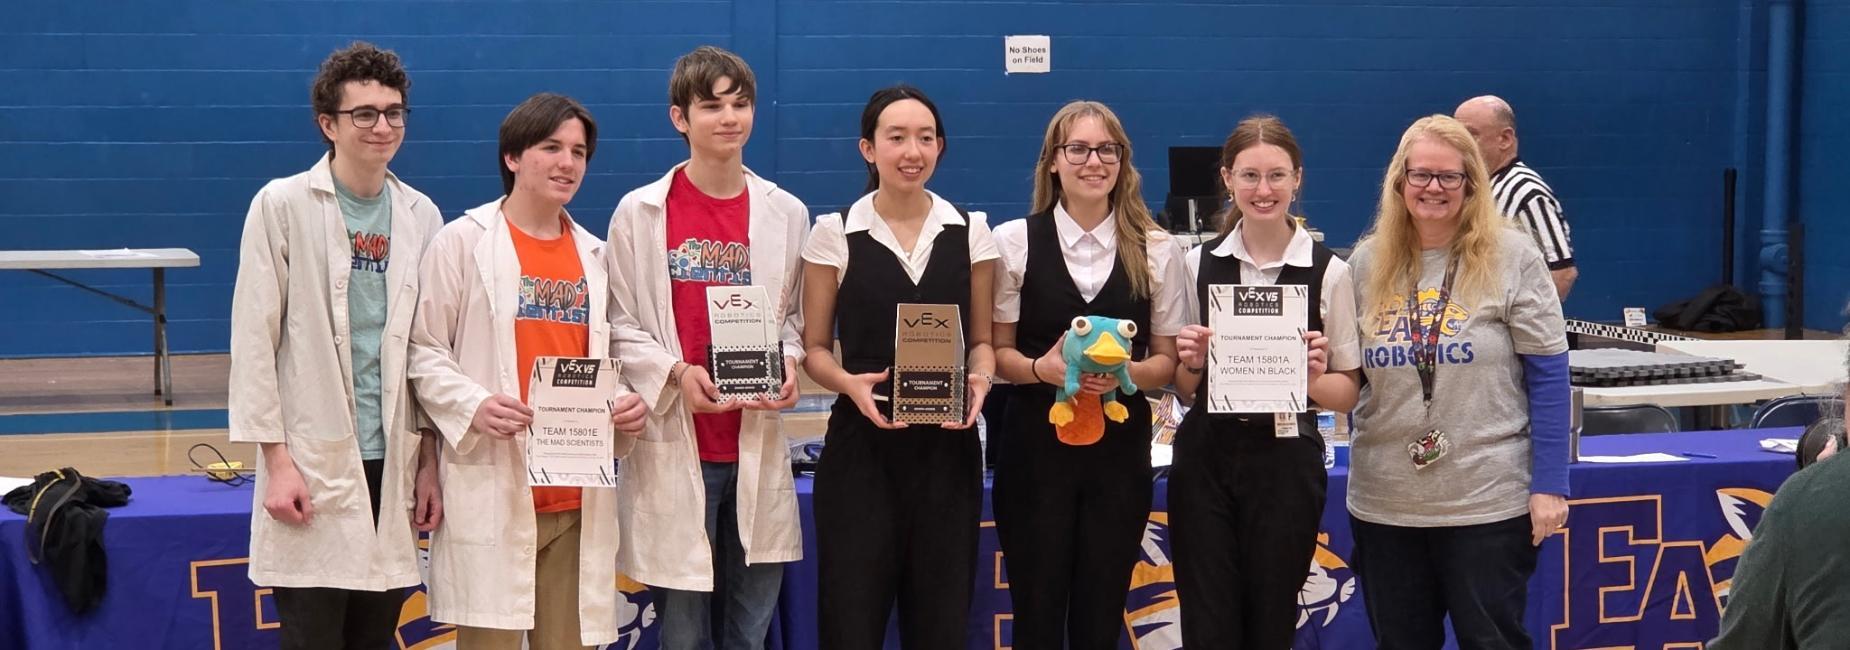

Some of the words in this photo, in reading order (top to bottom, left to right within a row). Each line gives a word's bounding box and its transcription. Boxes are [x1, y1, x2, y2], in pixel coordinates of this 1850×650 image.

[1009, 46, 1020, 54] No
[1022, 46, 1046, 54] Shoes
[1024, 56, 1044, 64] Field
[354, 230, 388, 262] MAD
[701, 241, 749, 273] MAD
[535, 278, 577, 309] MAD
[1238, 287, 1265, 301] VEX
[1266, 292, 1278, 301] V5
[713, 294, 759, 310] VEX
[903, 312, 949, 328] VEX
[1228, 356, 1254, 364] TEAM
[1257, 356, 1289, 364] 15801A
[1364, 342, 1475, 369] ROBOICS
[560, 360, 583, 374] VEX
[583, 364, 596, 374] V5
[1220, 367, 1255, 375] WOMEN
[1257, 367, 1266, 375] IN
[1268, 367, 1297, 375] BLACK
[556, 378, 593, 386] COMPETITION
[538, 406, 576, 414] TOURNAMENT
[542, 427, 567, 436] TEAM
[569, 427, 598, 437] 15801E
[536, 438, 549, 446] THE
[566, 439, 604, 447] SCIENTISTS
